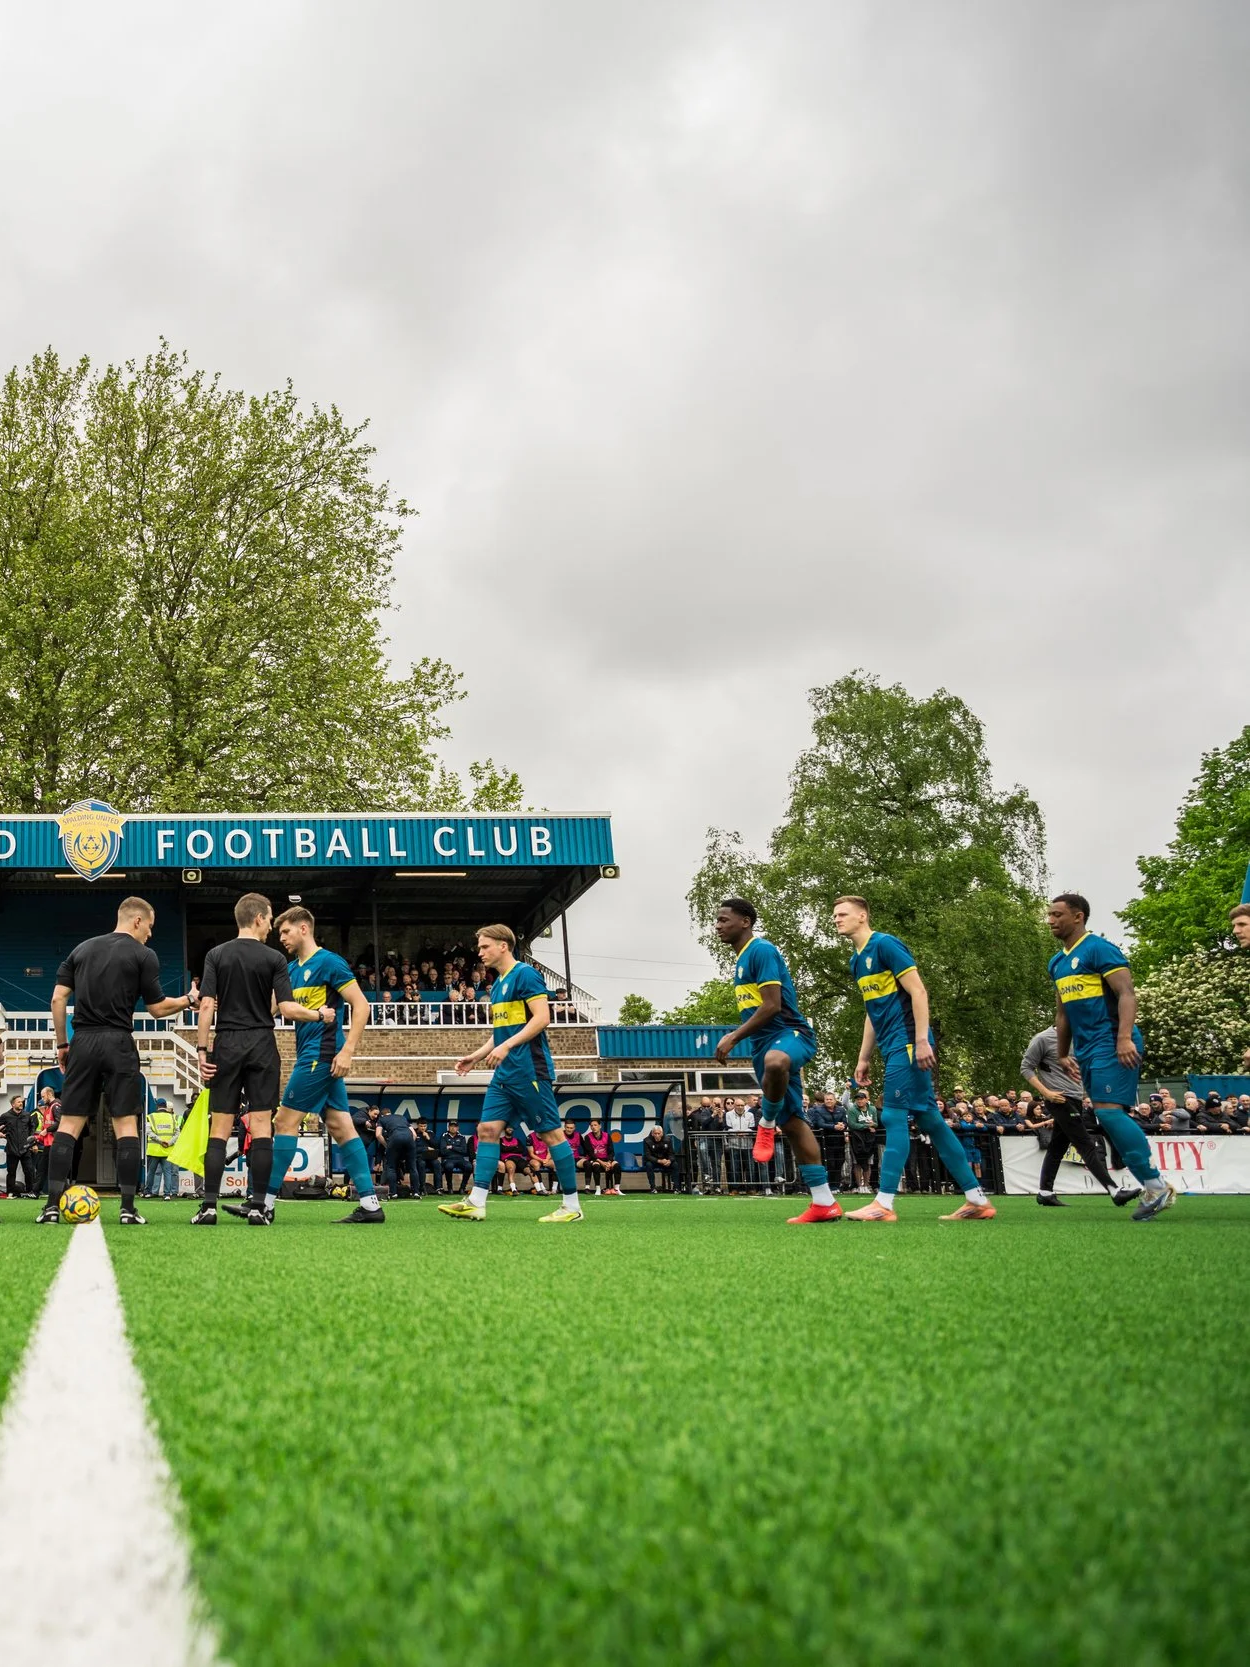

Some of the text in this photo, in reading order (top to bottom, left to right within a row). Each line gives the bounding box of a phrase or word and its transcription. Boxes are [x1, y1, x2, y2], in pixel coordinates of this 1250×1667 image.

[62, 814, 120, 825] SPALDING UNITED
[157, 827, 407, 860] FOOTBALL
[433, 826, 553, 858] CLUB
